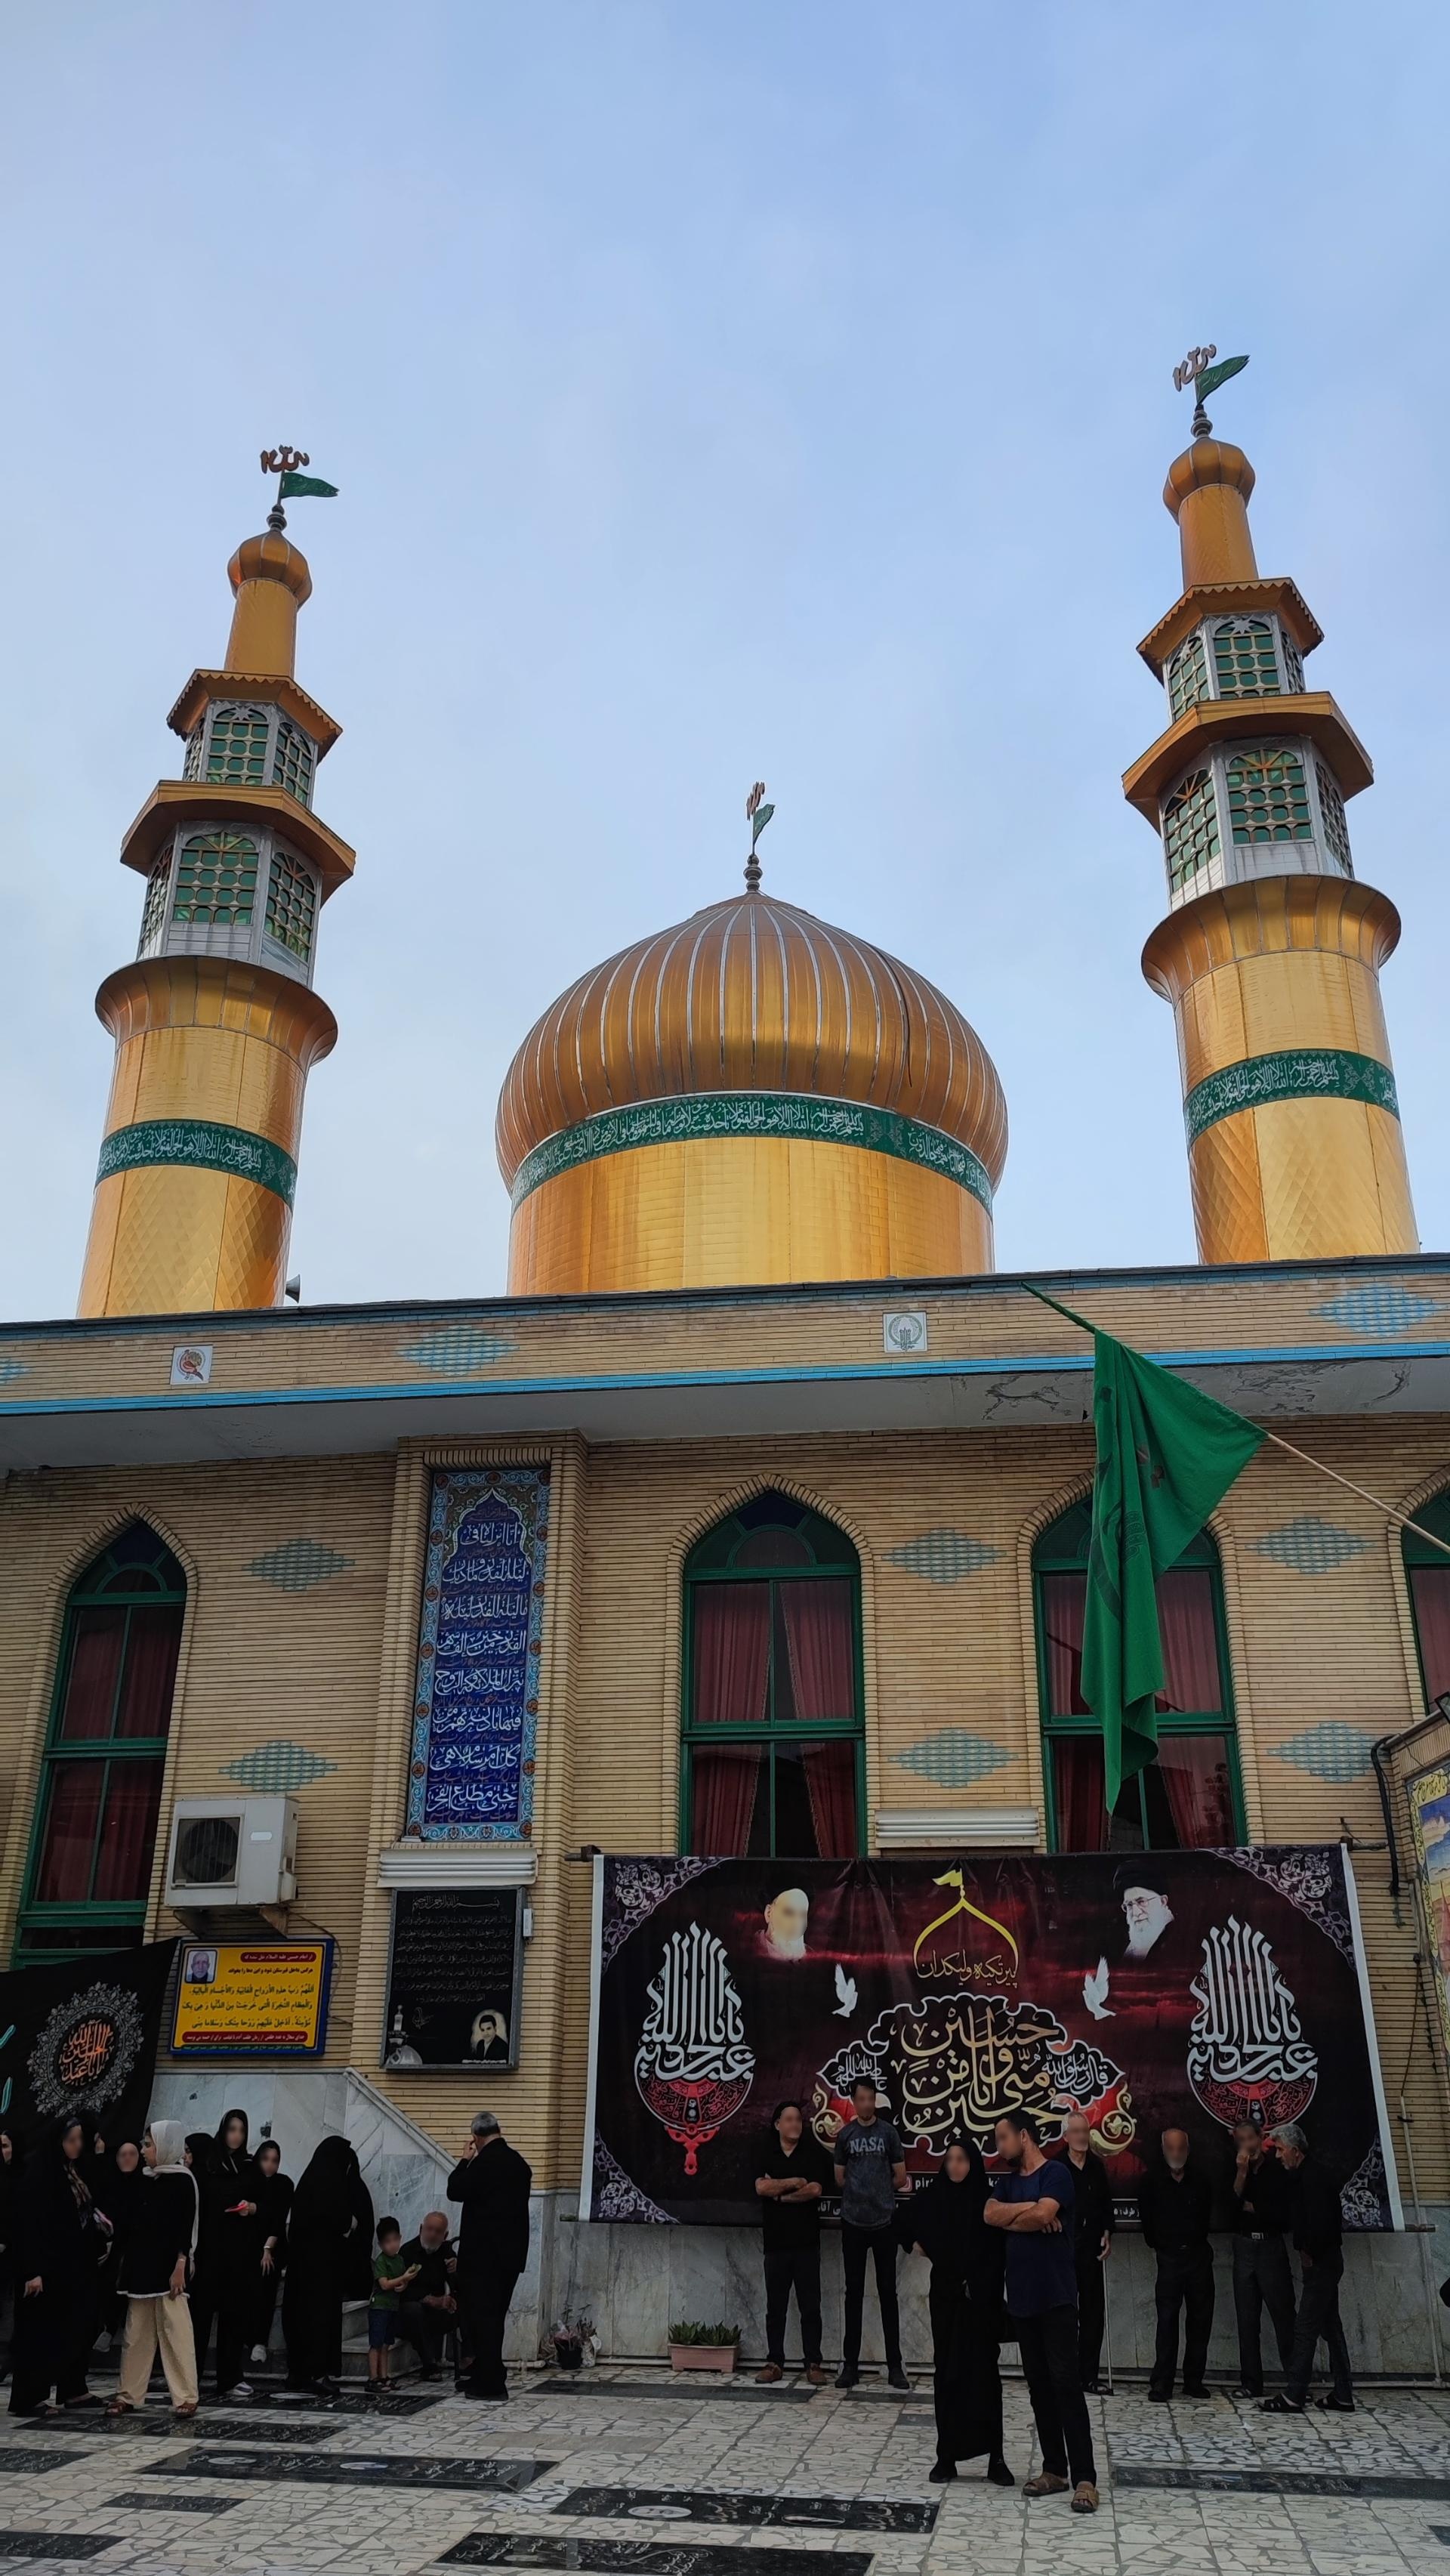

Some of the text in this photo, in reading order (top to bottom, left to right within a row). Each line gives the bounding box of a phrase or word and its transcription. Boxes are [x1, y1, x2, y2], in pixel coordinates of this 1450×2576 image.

[794, 1105, 809, 1130] الله
[973, 1954, 1004, 1986] تکیه
[901, 2015, 1060, 2057] حسین
[902, 2059, 970, 2105] من
[1069, 2053, 1109, 2096] قال
[850, 2136, 886, 2154] NASA
